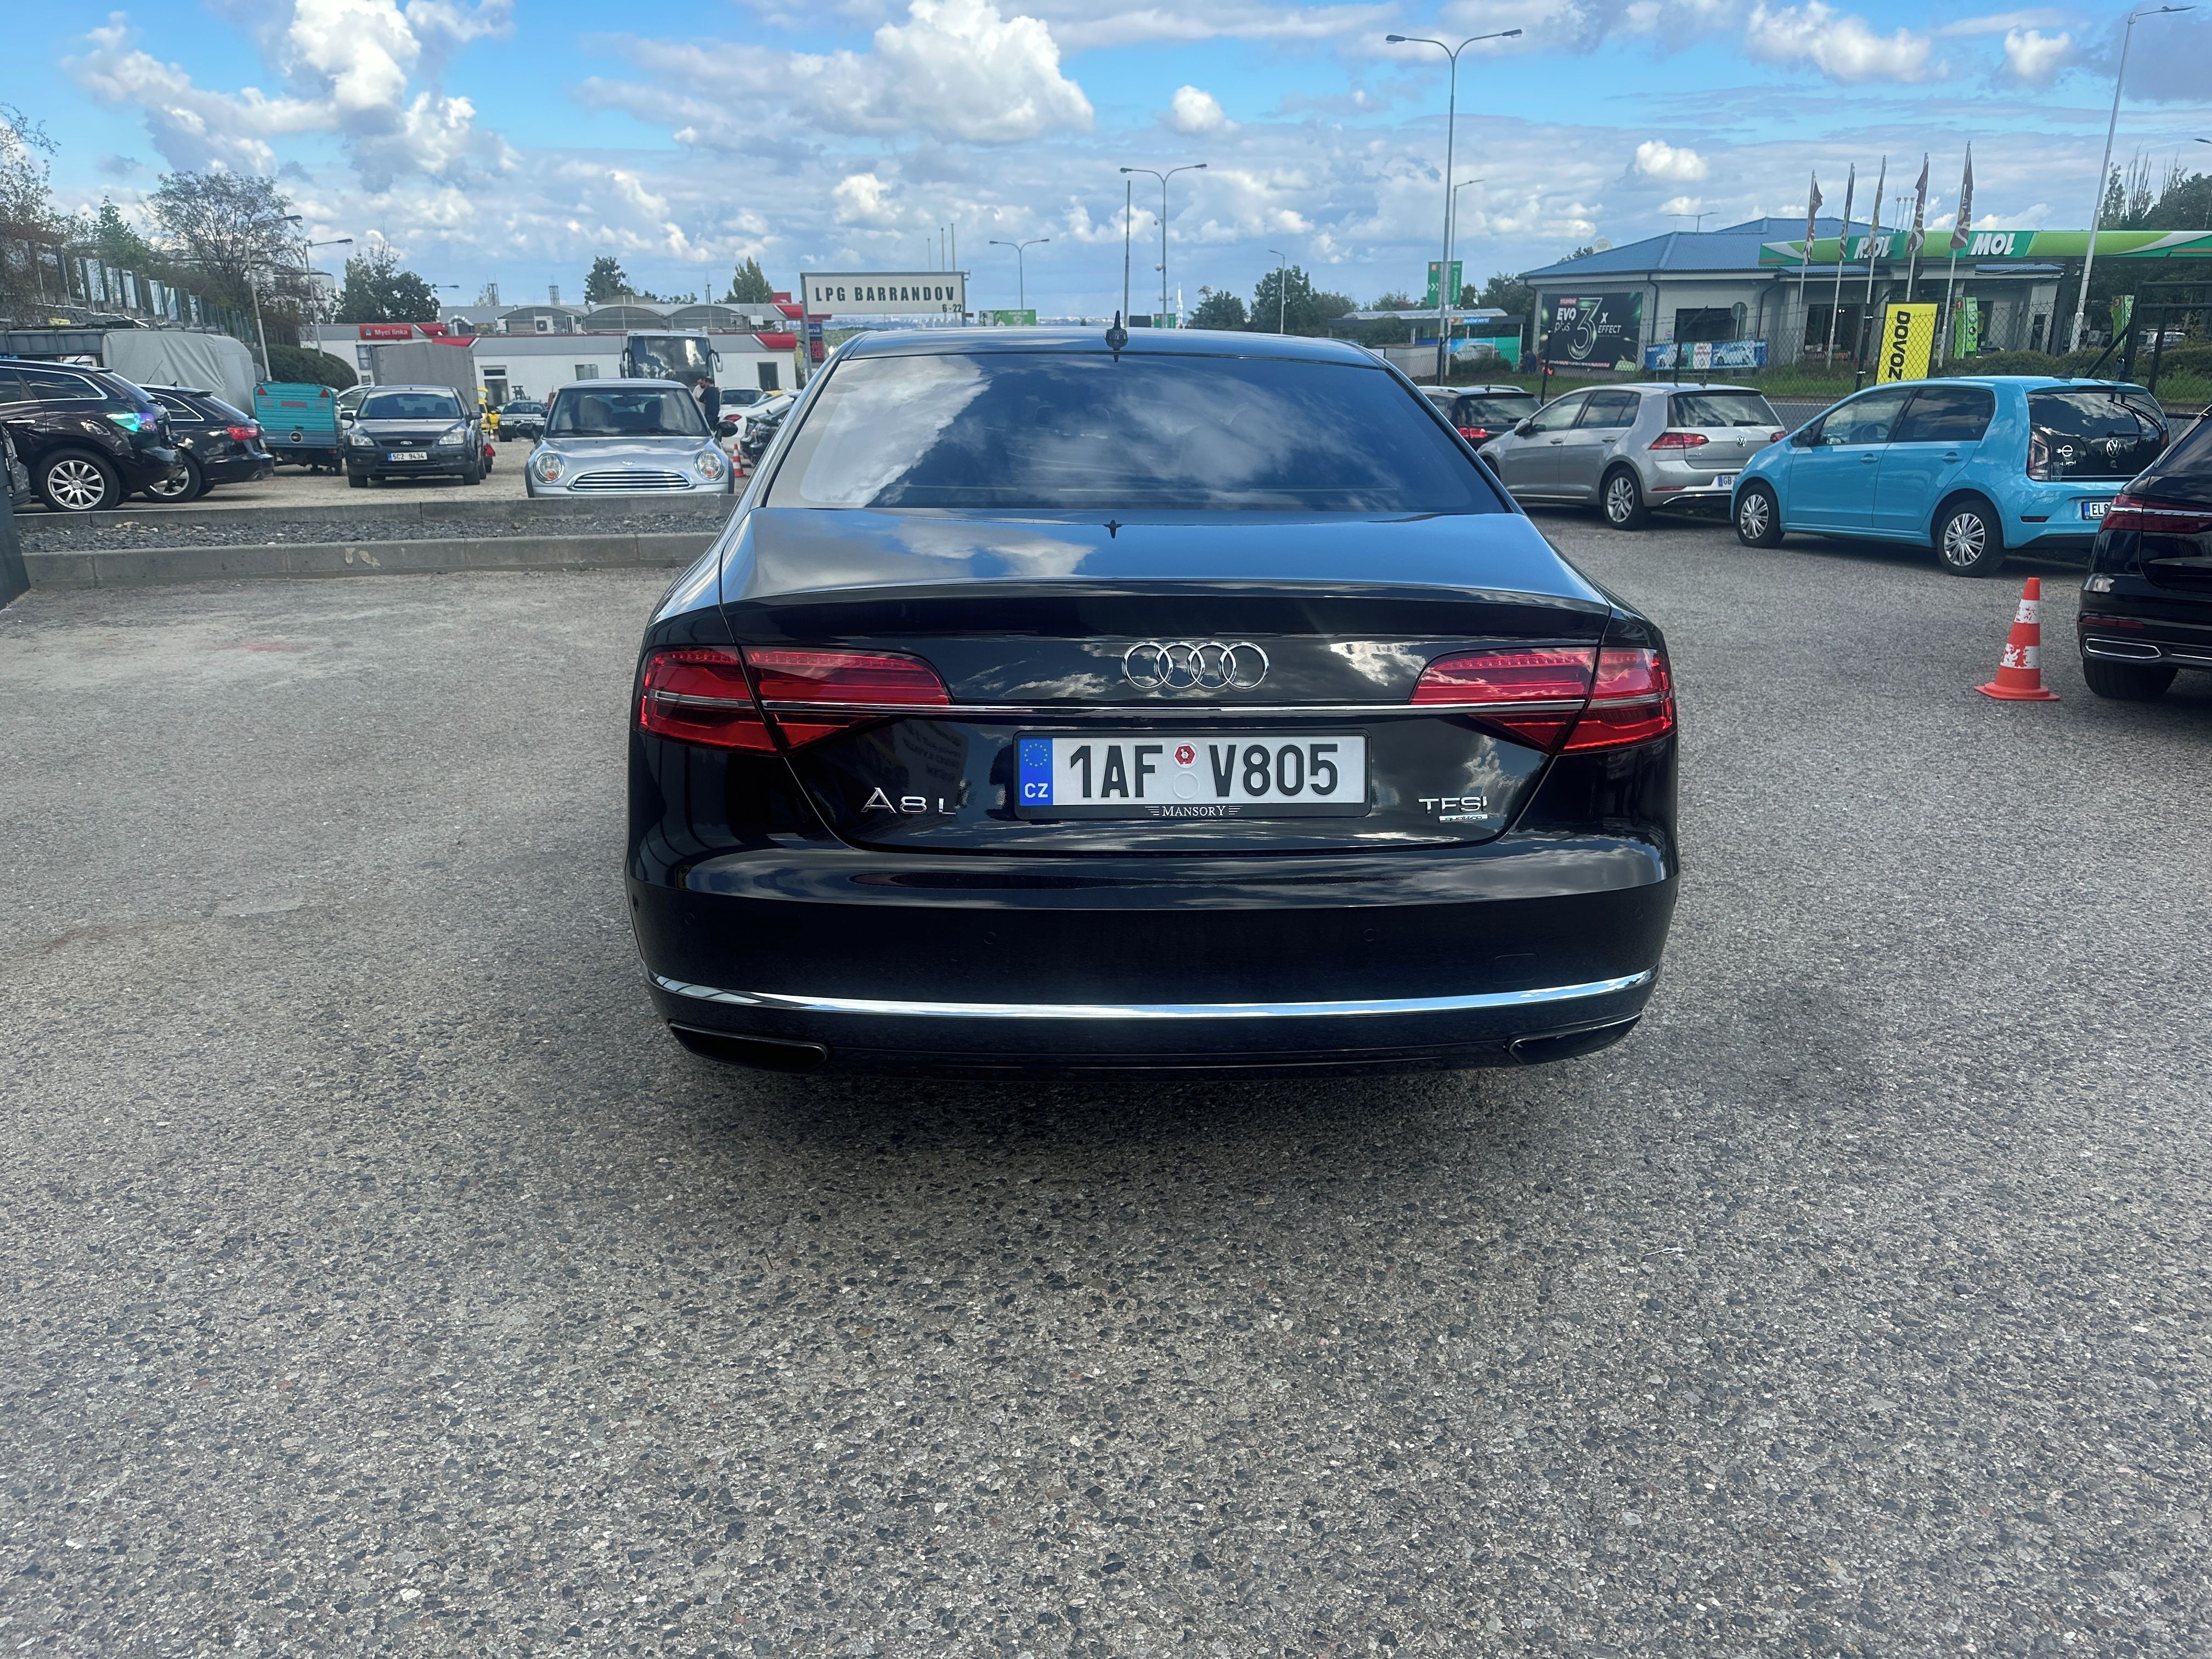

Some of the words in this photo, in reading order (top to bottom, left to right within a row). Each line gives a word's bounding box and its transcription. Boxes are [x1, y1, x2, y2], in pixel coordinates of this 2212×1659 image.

[1970, 233, 2015, 256] MOL
[815, 287, 845, 301] LPG
[854, 286, 954, 301] BARRANDOV
[1556, 307, 1577, 321] EVO
[1600, 312, 1609, 324] X
[1598, 325, 1621, 334] EFFECT
[1888, 311, 1911, 380] DOVOZ
[1070, 745, 1163, 798] 1AF
[1209, 743, 1338, 798] V805
[1024, 782, 1049, 799] CZ
[861, 787, 928, 814] A8
[938, 798, 956, 815] L
[1418, 796, 1487, 814] TFSI
[1161, 805, 1226, 816] MANSORY
